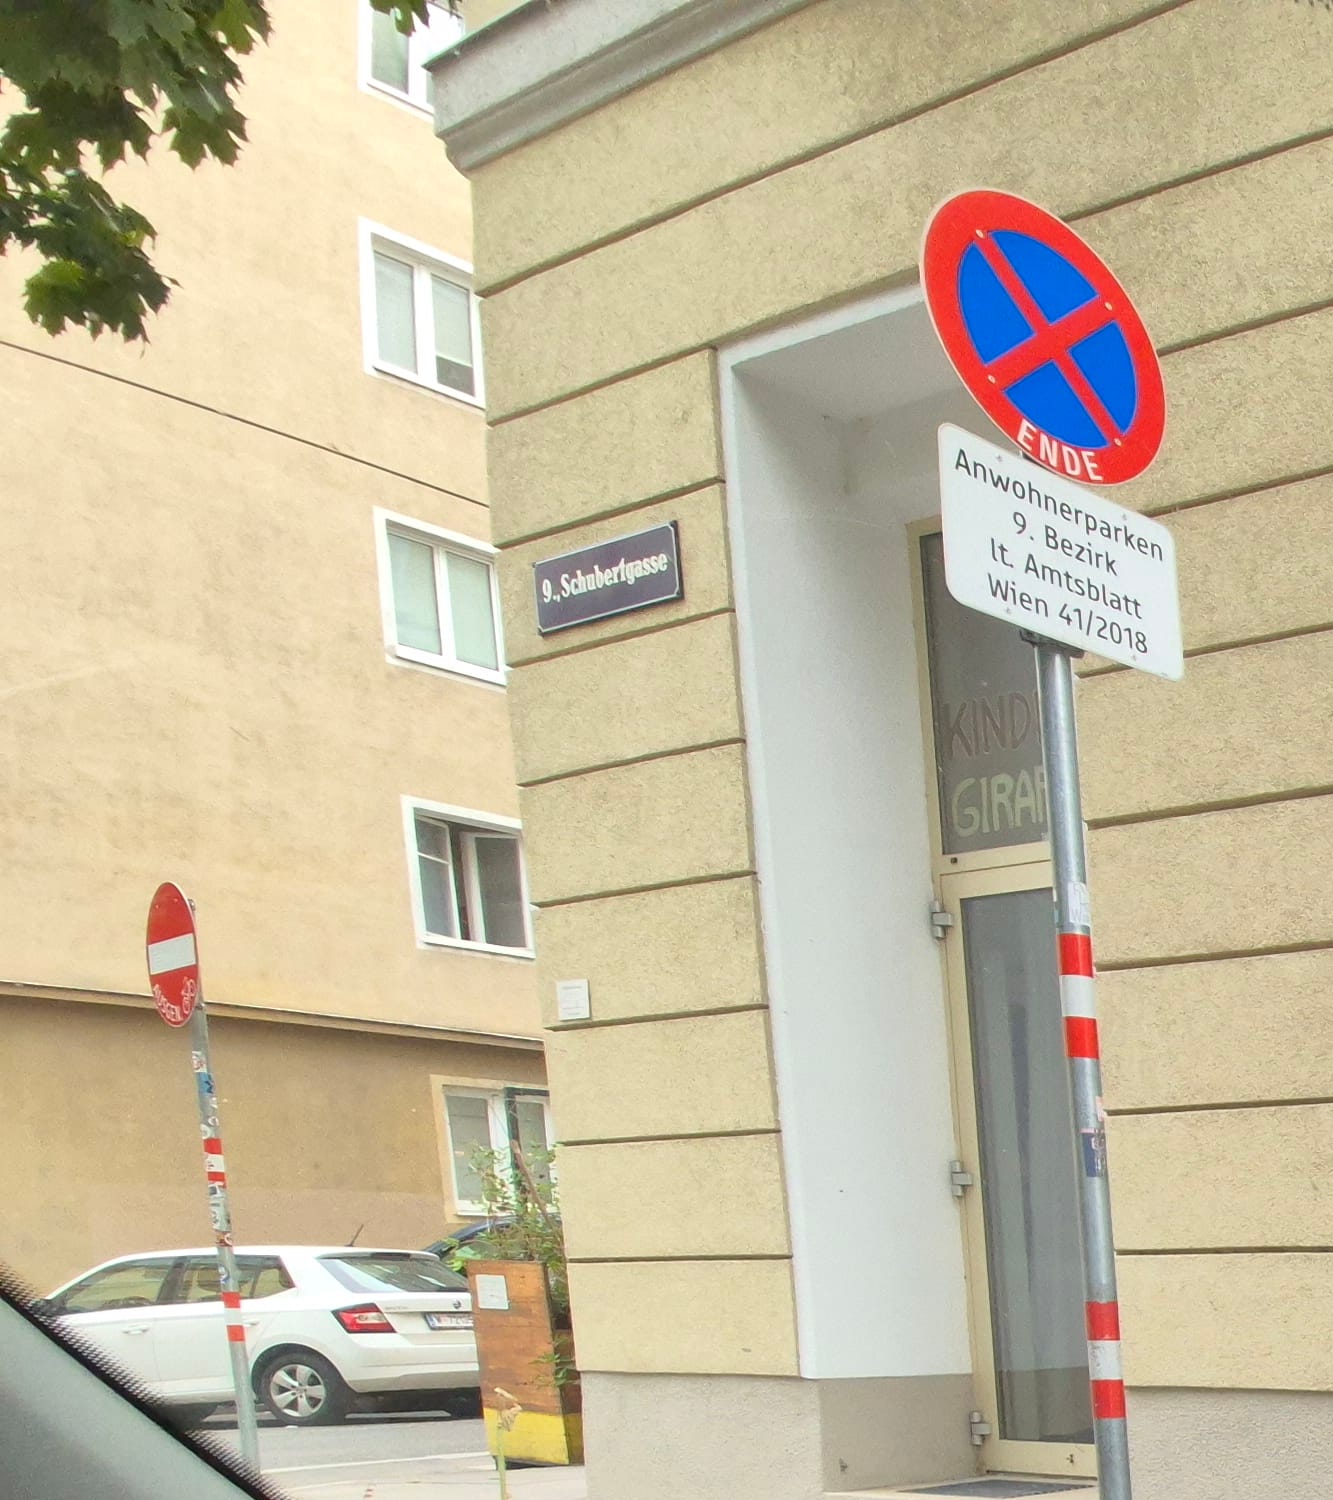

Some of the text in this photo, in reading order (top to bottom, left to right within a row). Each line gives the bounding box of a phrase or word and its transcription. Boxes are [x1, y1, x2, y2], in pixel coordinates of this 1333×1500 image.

[1017, 418, 1103, 480] ENDE
[954, 449, 1164, 561] Anwohnerparken
[561, 553, 668, 597] Schubertgasse
[1012, 511, 1118, 576] 9. Bezirk
[987, 574, 1148, 655] Wien 41/2018
[1023, 554, 1143, 619] Amtsblatt
[943, 690, 1042, 760] KIND
